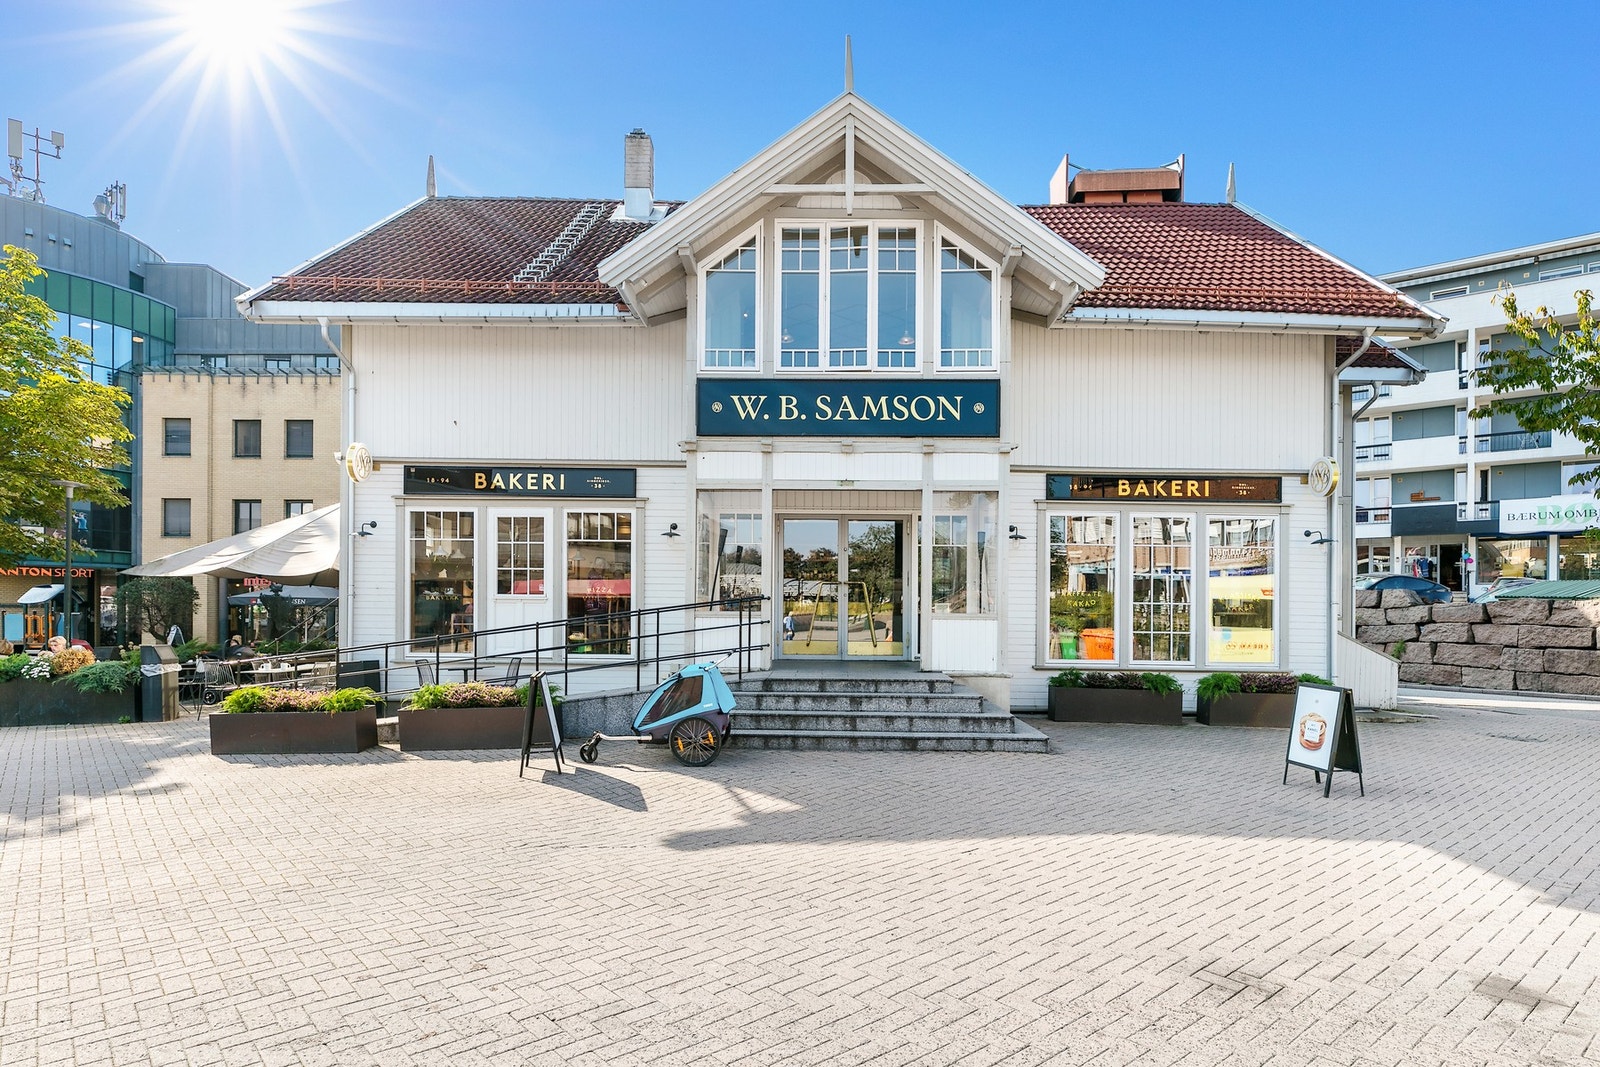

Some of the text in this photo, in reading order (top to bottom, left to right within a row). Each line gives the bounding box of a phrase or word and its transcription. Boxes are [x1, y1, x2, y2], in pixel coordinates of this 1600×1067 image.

[730, 395, 770, 420] W.
[778, 395, 807, 421] B.
[815, 395, 963, 421] SAMSON
[474, 472, 565, 490] BAKERI
[1118, 479, 1210, 497] BAKERI
[1507, 508, 1600, 521] BÆRUM OMB
[54, 568, 95, 578] SPORT
[587, 586, 613, 594] PIZZA
[1067, 599, 1096, 607] KAKAO
